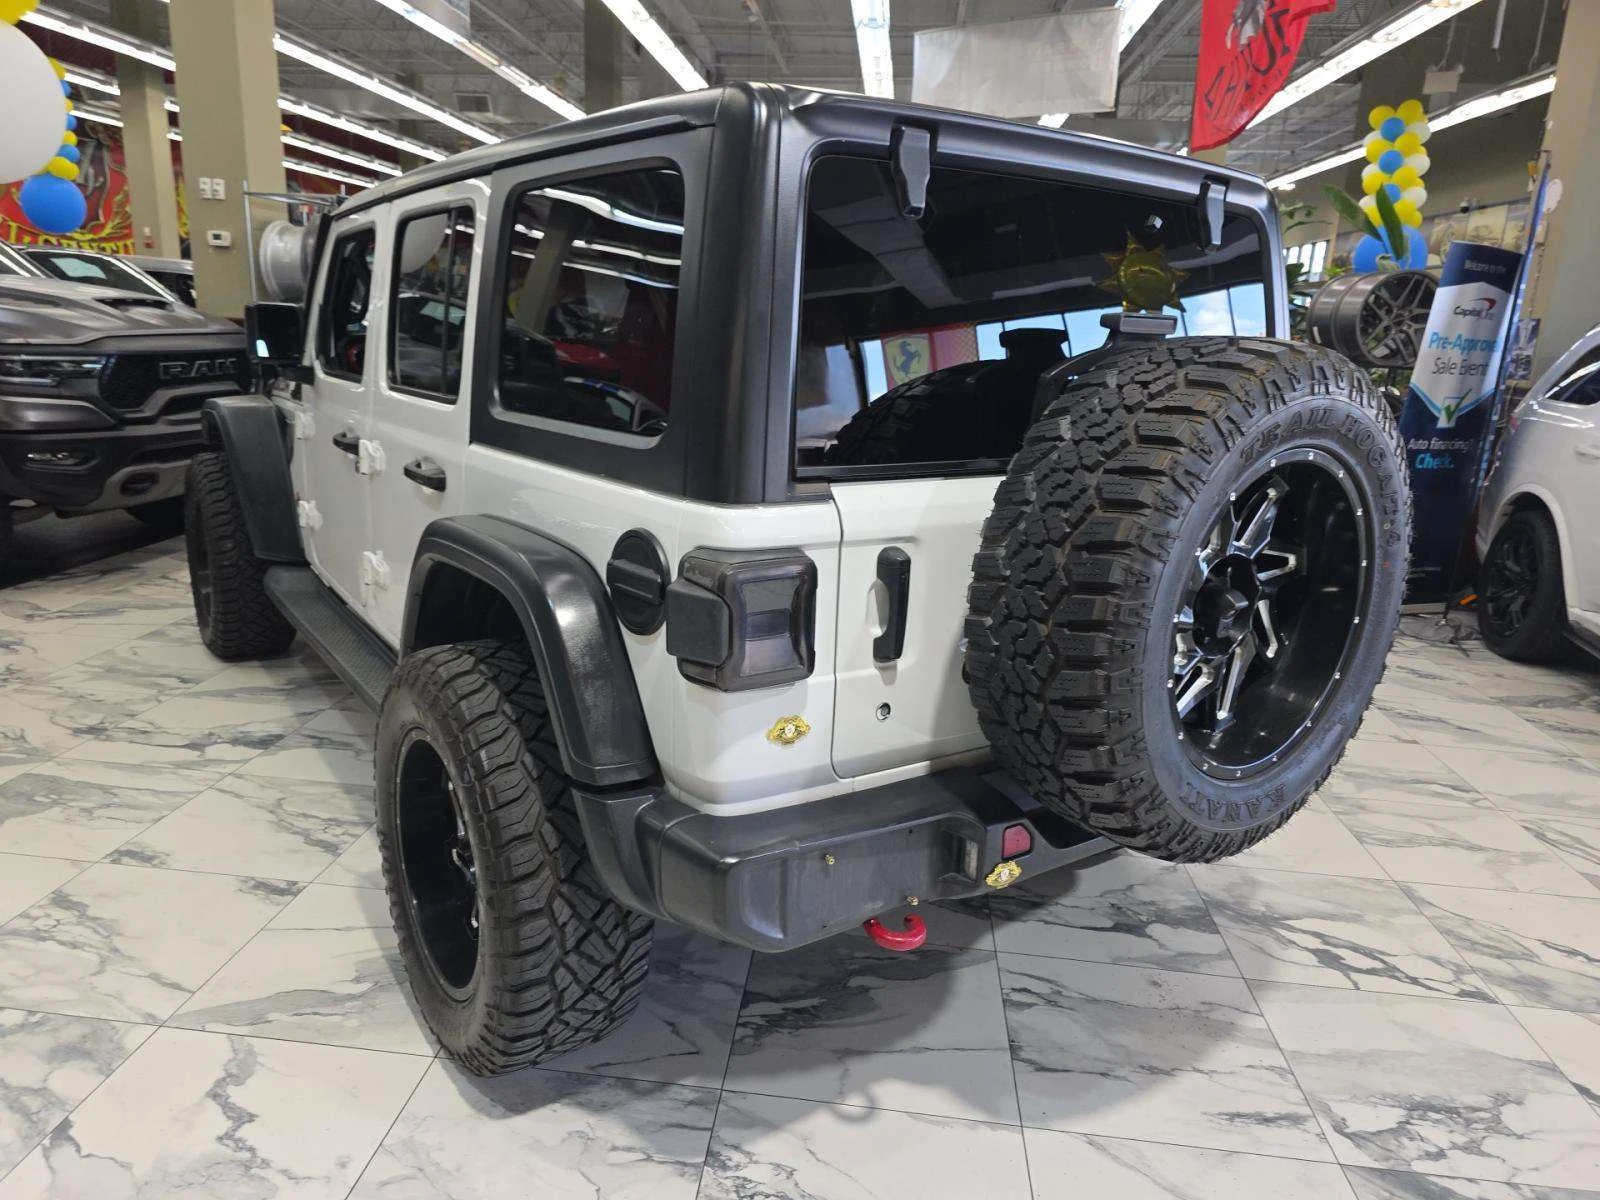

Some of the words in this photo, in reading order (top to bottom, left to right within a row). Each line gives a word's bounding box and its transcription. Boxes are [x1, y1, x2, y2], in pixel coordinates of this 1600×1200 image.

[160, 358, 237, 379] RAM
[1432, 356, 1457, 376] Sale
[1239, 405, 1337, 466] TRAIL
[1407, 438, 1429, 450] Auto
